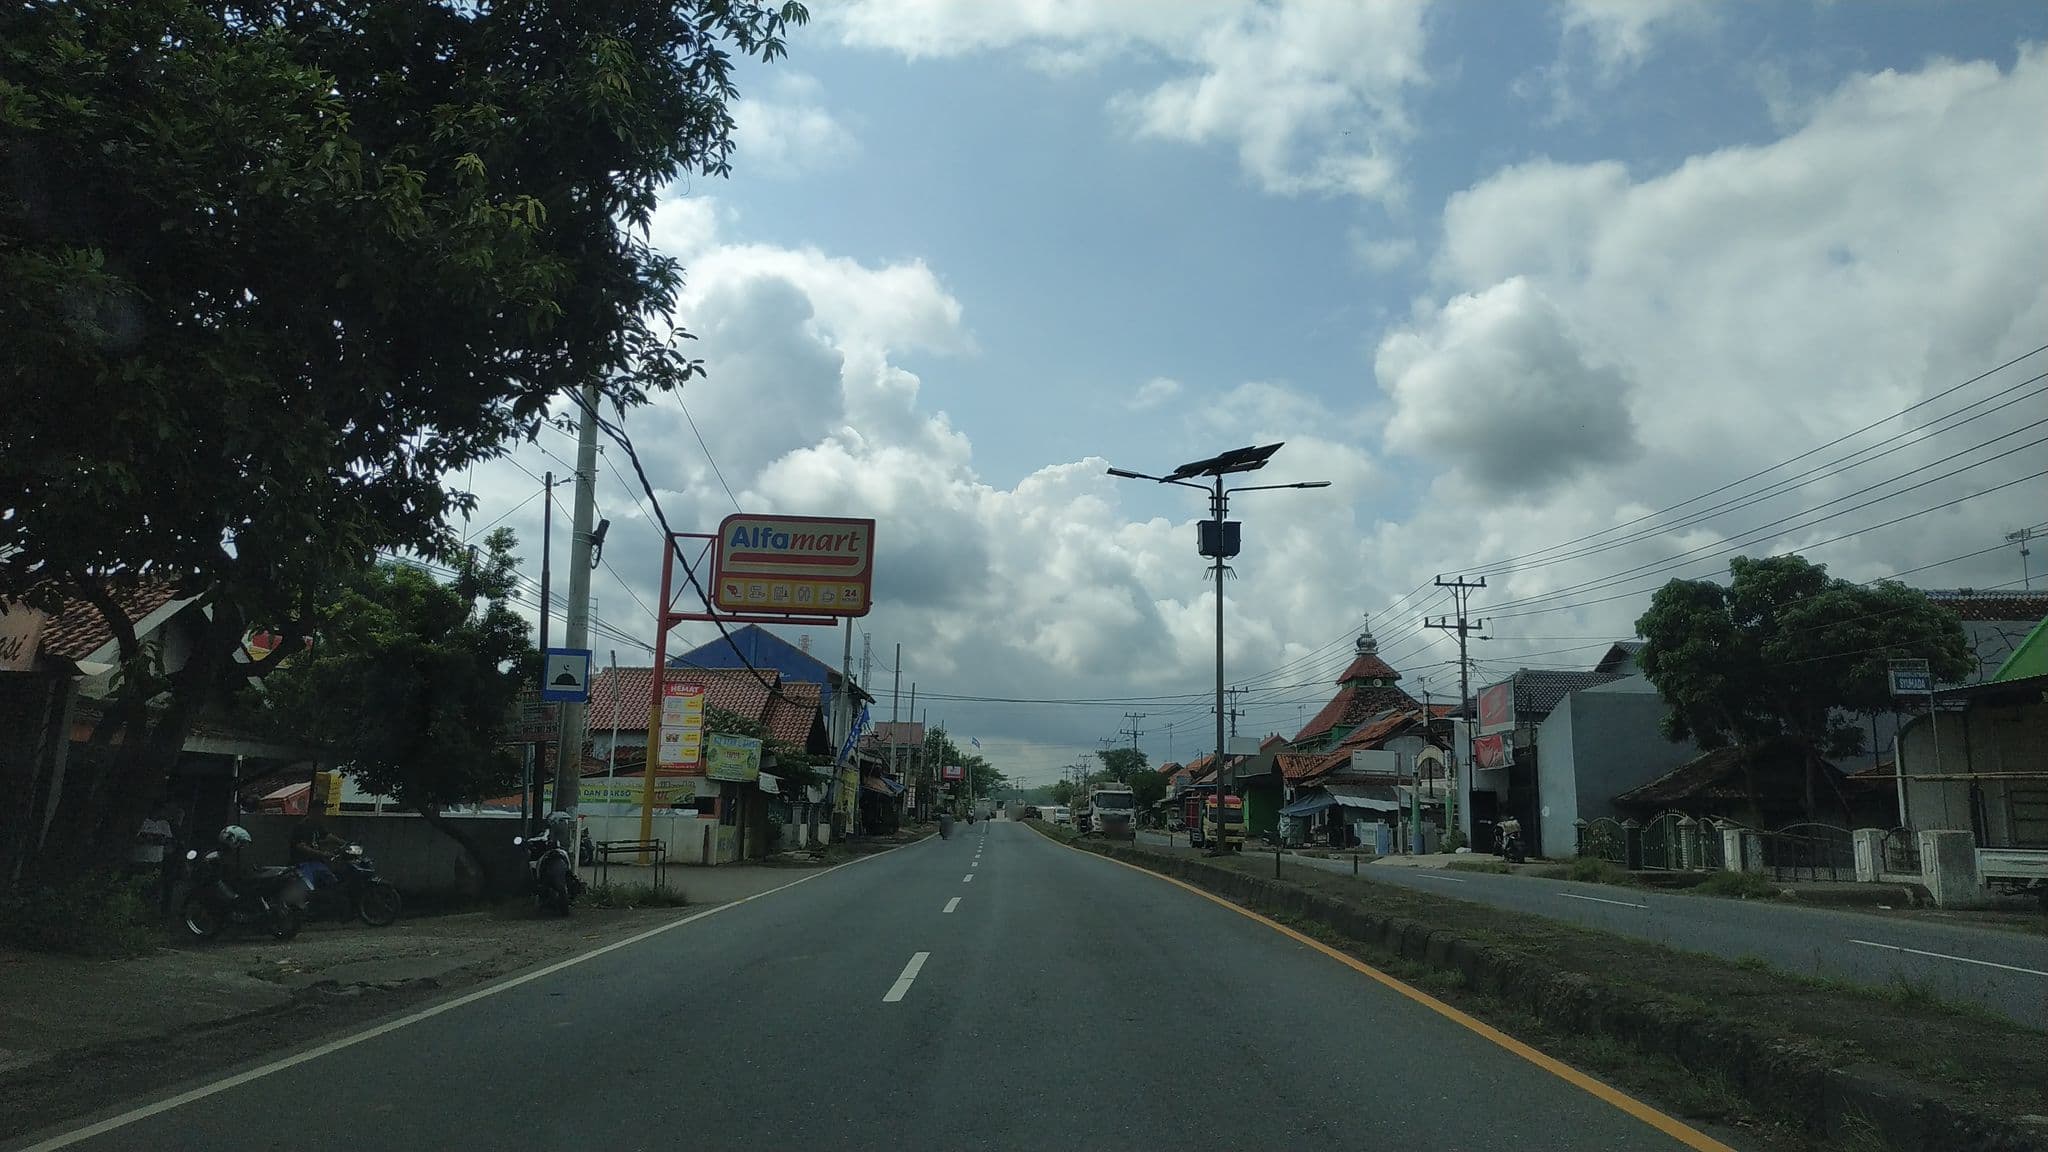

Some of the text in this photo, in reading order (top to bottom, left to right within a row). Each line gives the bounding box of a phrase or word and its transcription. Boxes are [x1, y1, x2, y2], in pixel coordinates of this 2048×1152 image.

[731, 526, 860, 552] Alfamart
[845, 589, 857, 597] 24
[670, 685, 699, 693] HEMAT
[603, 789, 632, 797] BAKSO
